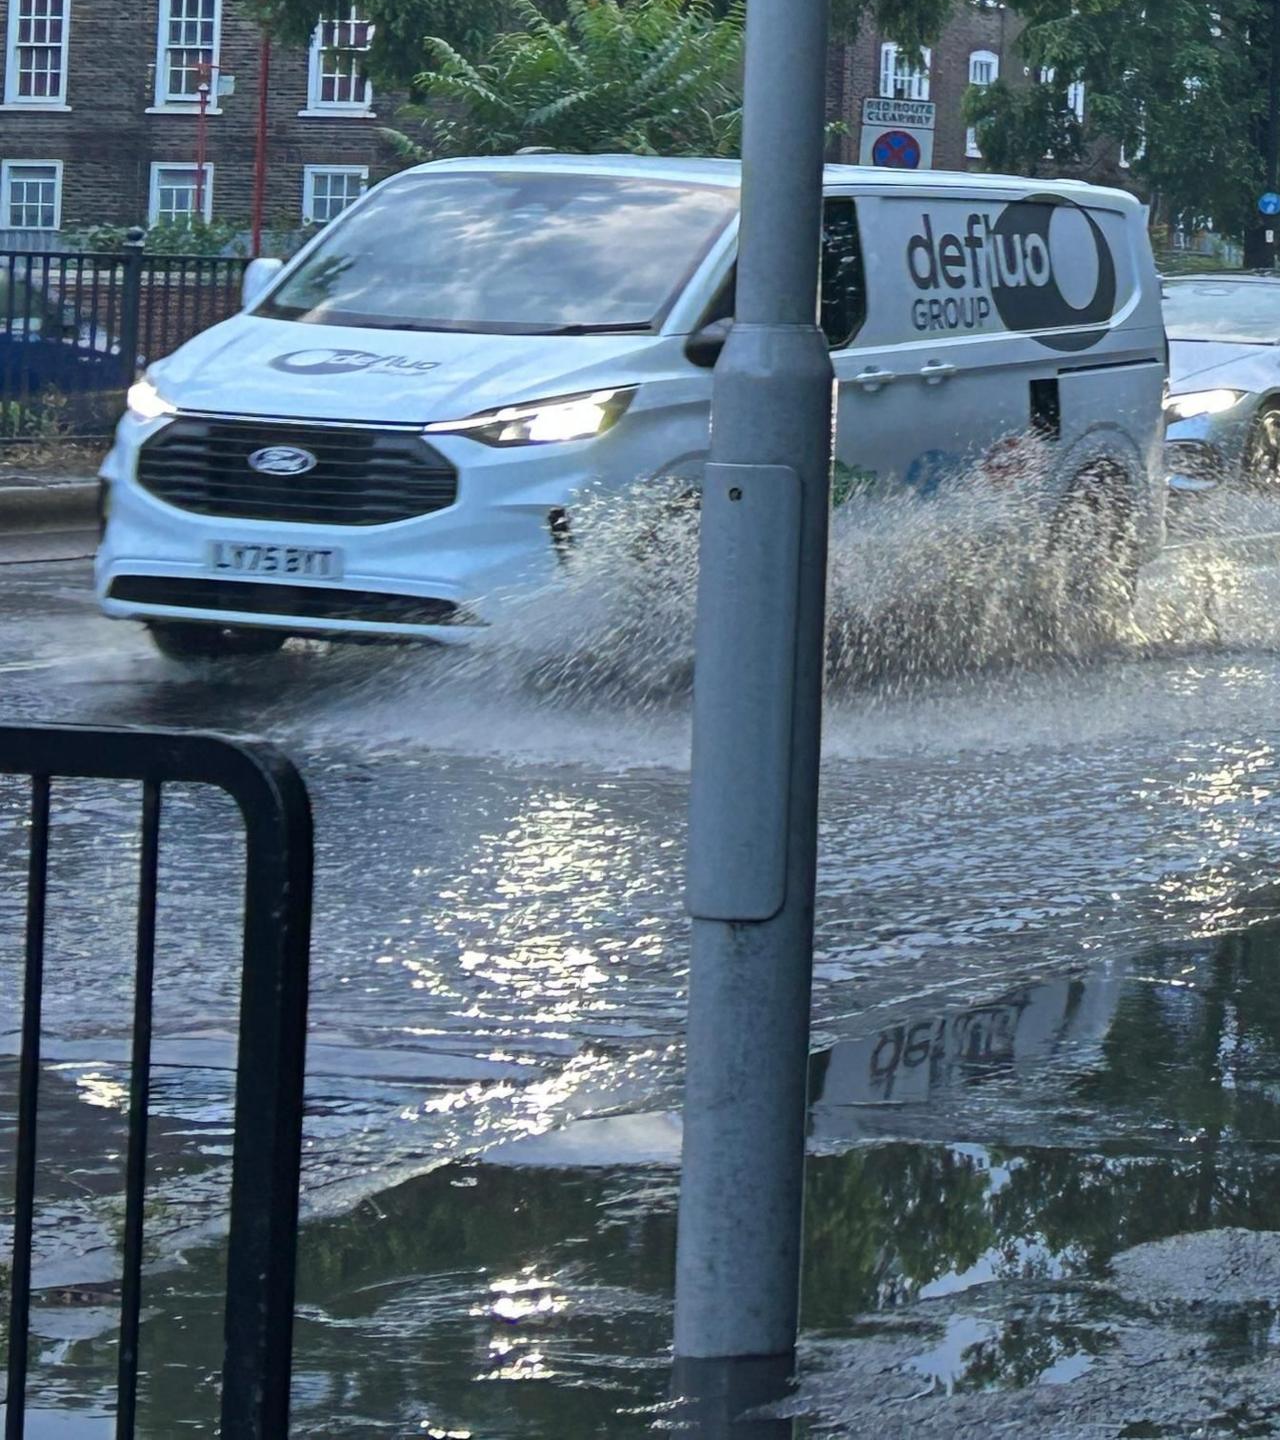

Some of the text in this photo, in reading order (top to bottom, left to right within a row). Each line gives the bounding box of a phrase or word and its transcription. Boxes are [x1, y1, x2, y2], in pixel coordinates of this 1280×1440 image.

[867, 100, 934, 115] RED ROUTE
[867, 110, 932, 125] CLEARWAY
[907, 213, 1050, 290] defluo
[912, 295, 991, 332] GROUP
